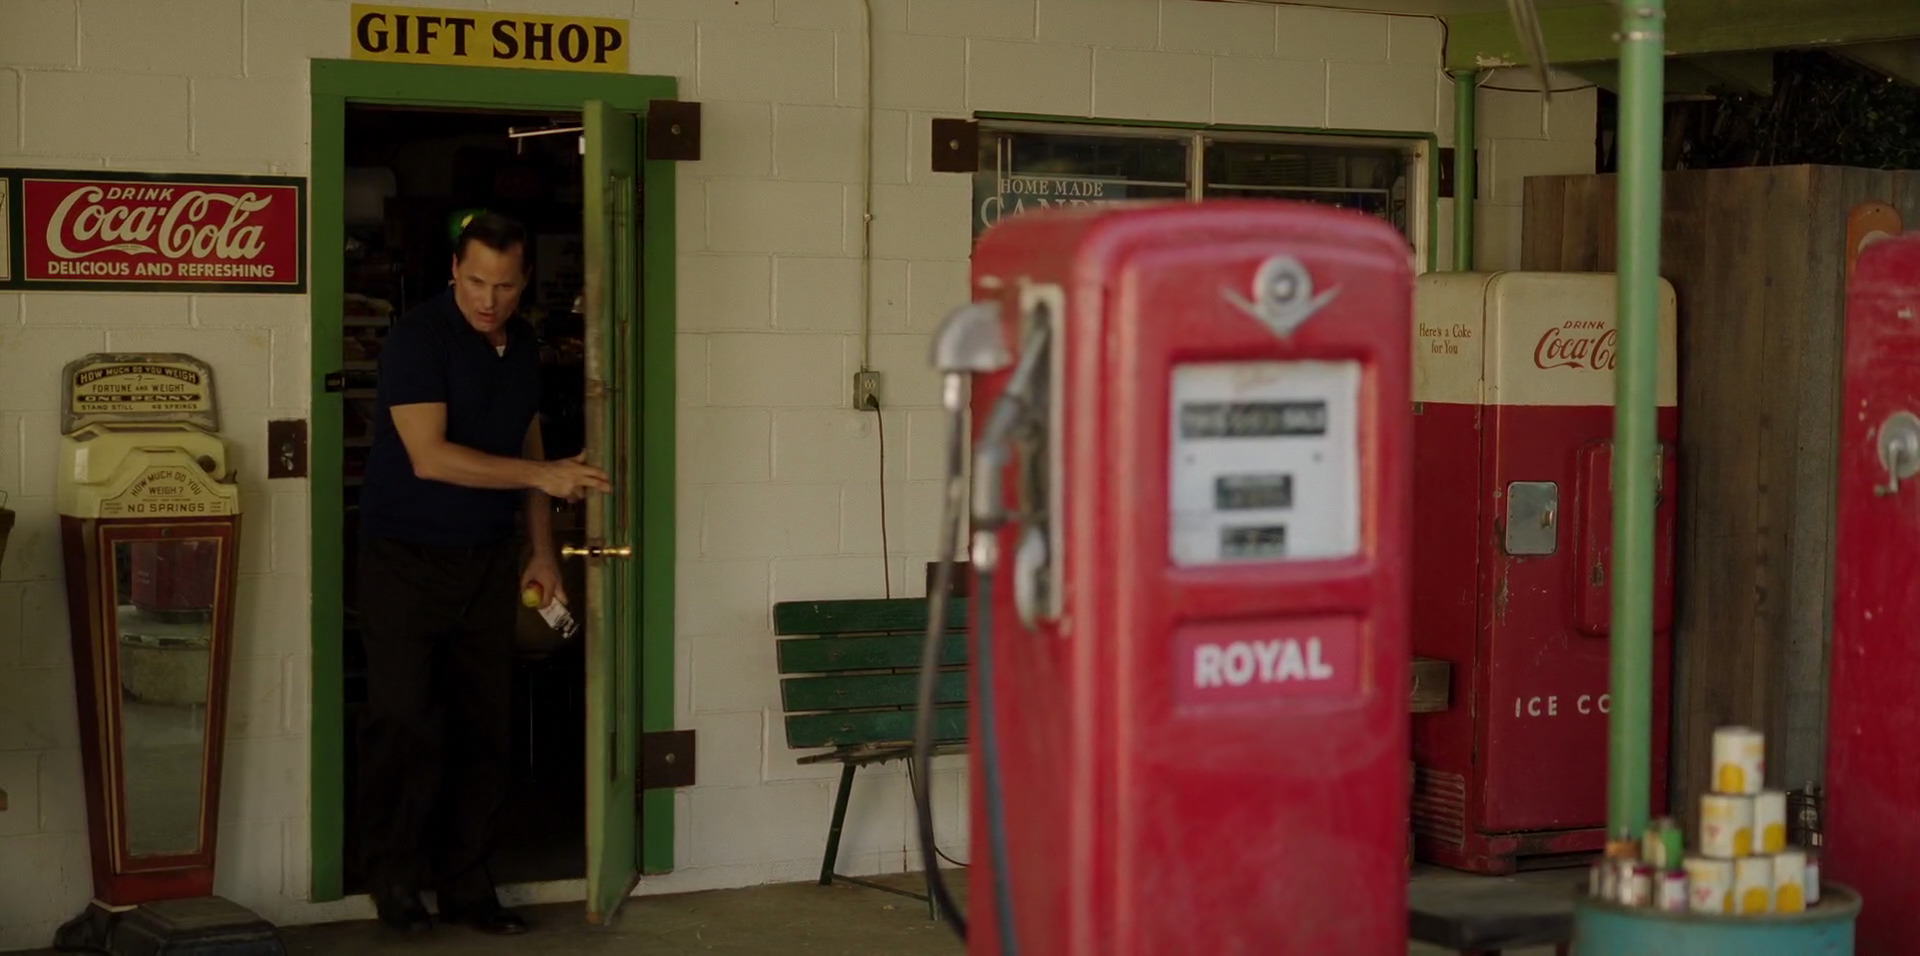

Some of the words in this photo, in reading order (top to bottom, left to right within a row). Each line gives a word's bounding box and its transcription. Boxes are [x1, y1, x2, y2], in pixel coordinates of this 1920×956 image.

[357, 13, 475, 56] GIFT
[492, 20, 622, 63] SHOP
[106, 187, 175, 201] DRINK
[1001, 179, 1049, 195] HOME
[1055, 181, 1104, 197] MADE
[46, 185, 273, 260] Coca-Cola
[48, 261, 130, 276] DELICIOUS
[135, 262, 172, 276] AND
[178, 263, 275, 278] REFRESHING
[1419, 322, 1442, 337] Here's
[1452, 323, 1472, 338] Coke
[1563, 320, 1606, 330] DRINK
[1431, 340, 1443, 354] for
[1444, 340, 1459, 355] You
[1534, 327, 1617, 370] Coca-Co
[80, 371, 103, 384] HOW
[105, 366, 130, 376] MUCH
[144, 367, 163, 375] YOU
[165, 368, 197, 384] WEIGH
[92, 384, 132, 393] FORTUNE
[152, 384, 184, 393] WEIGHT
[131, 479, 147, 497] HOW
[147, 471, 172, 482] MUCH
[174, 472, 187, 482] DO
[188, 479, 202, 496] YOU
[127, 503, 145, 513] NO
[150, 503, 205, 512] SPRINGS
[1194, 636, 1334, 688] ROYAL
[1515, 695, 1558, 718] ICE
[1577, 694, 1611, 715] CO
